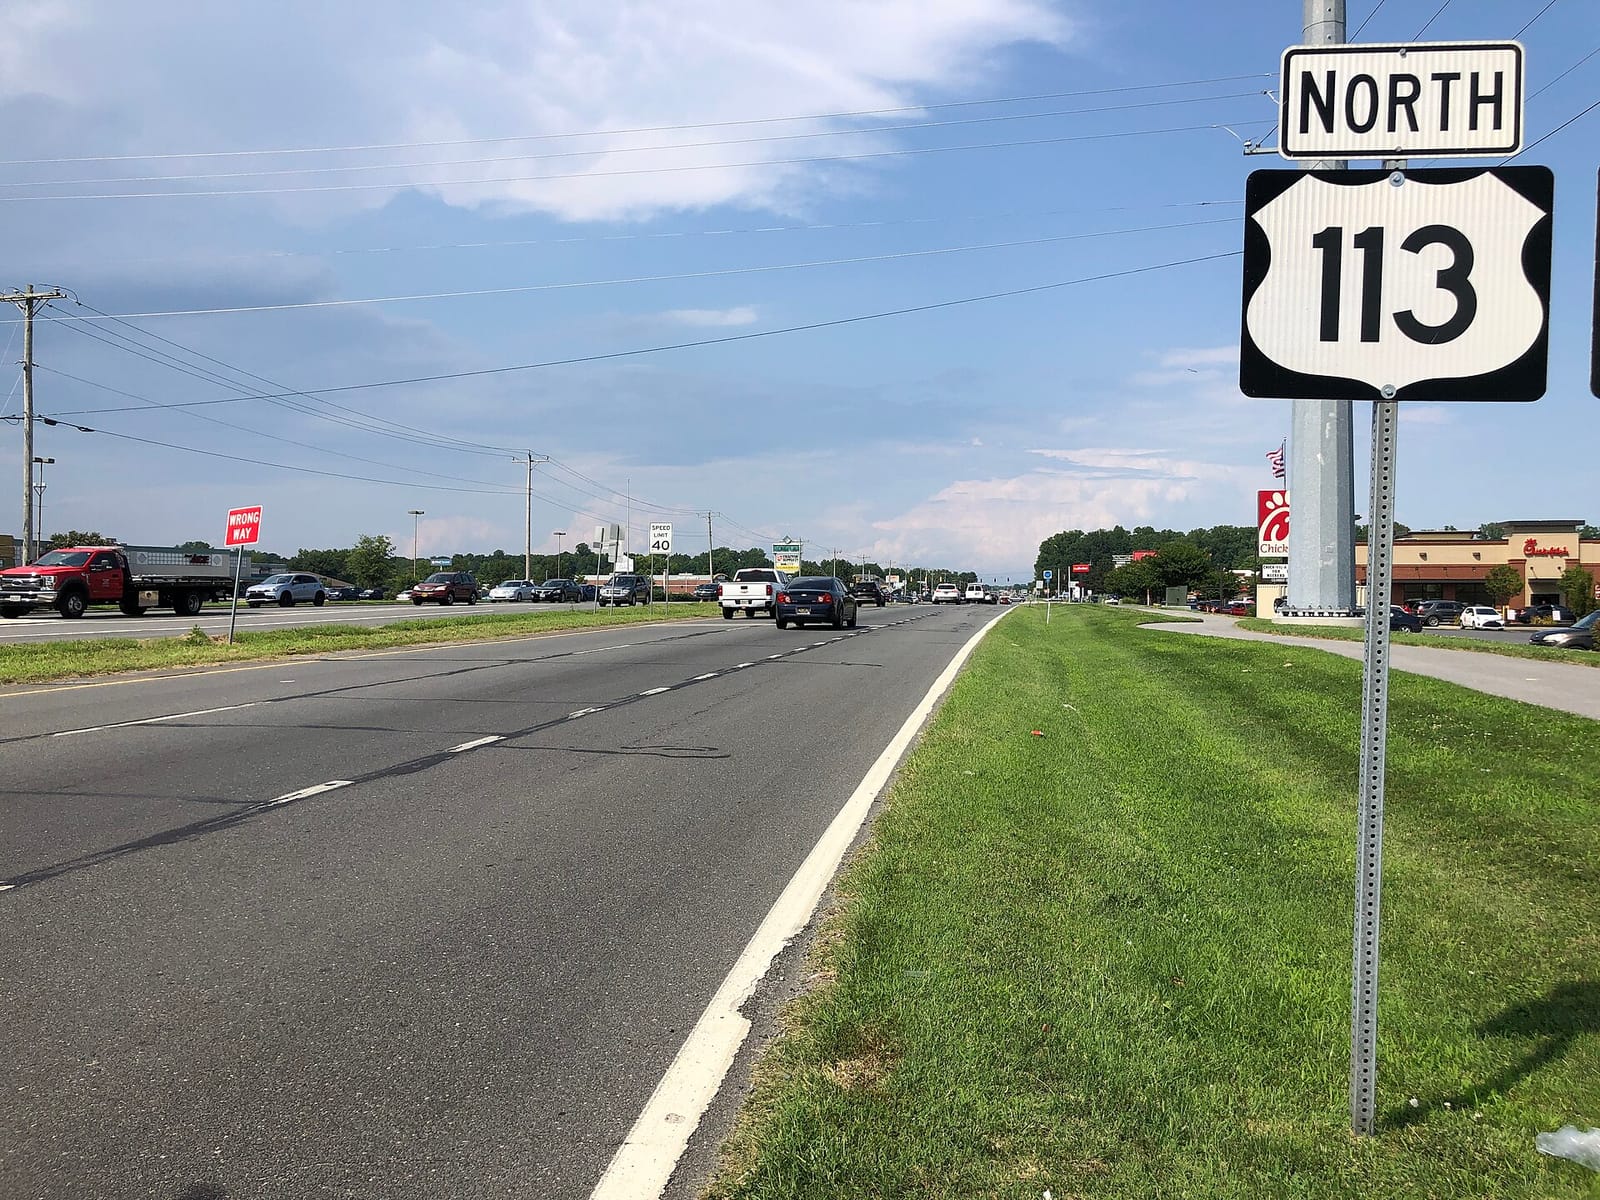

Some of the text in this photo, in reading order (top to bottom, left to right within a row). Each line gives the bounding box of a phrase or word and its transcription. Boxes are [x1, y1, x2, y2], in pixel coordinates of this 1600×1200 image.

[1299, 70, 1503, 135] NORTH
[1312, 224, 1478, 345] 113
[230, 512, 260, 526] WRONG
[233, 528, 251, 540] WAY
[652, 540, 670, 550] 40
